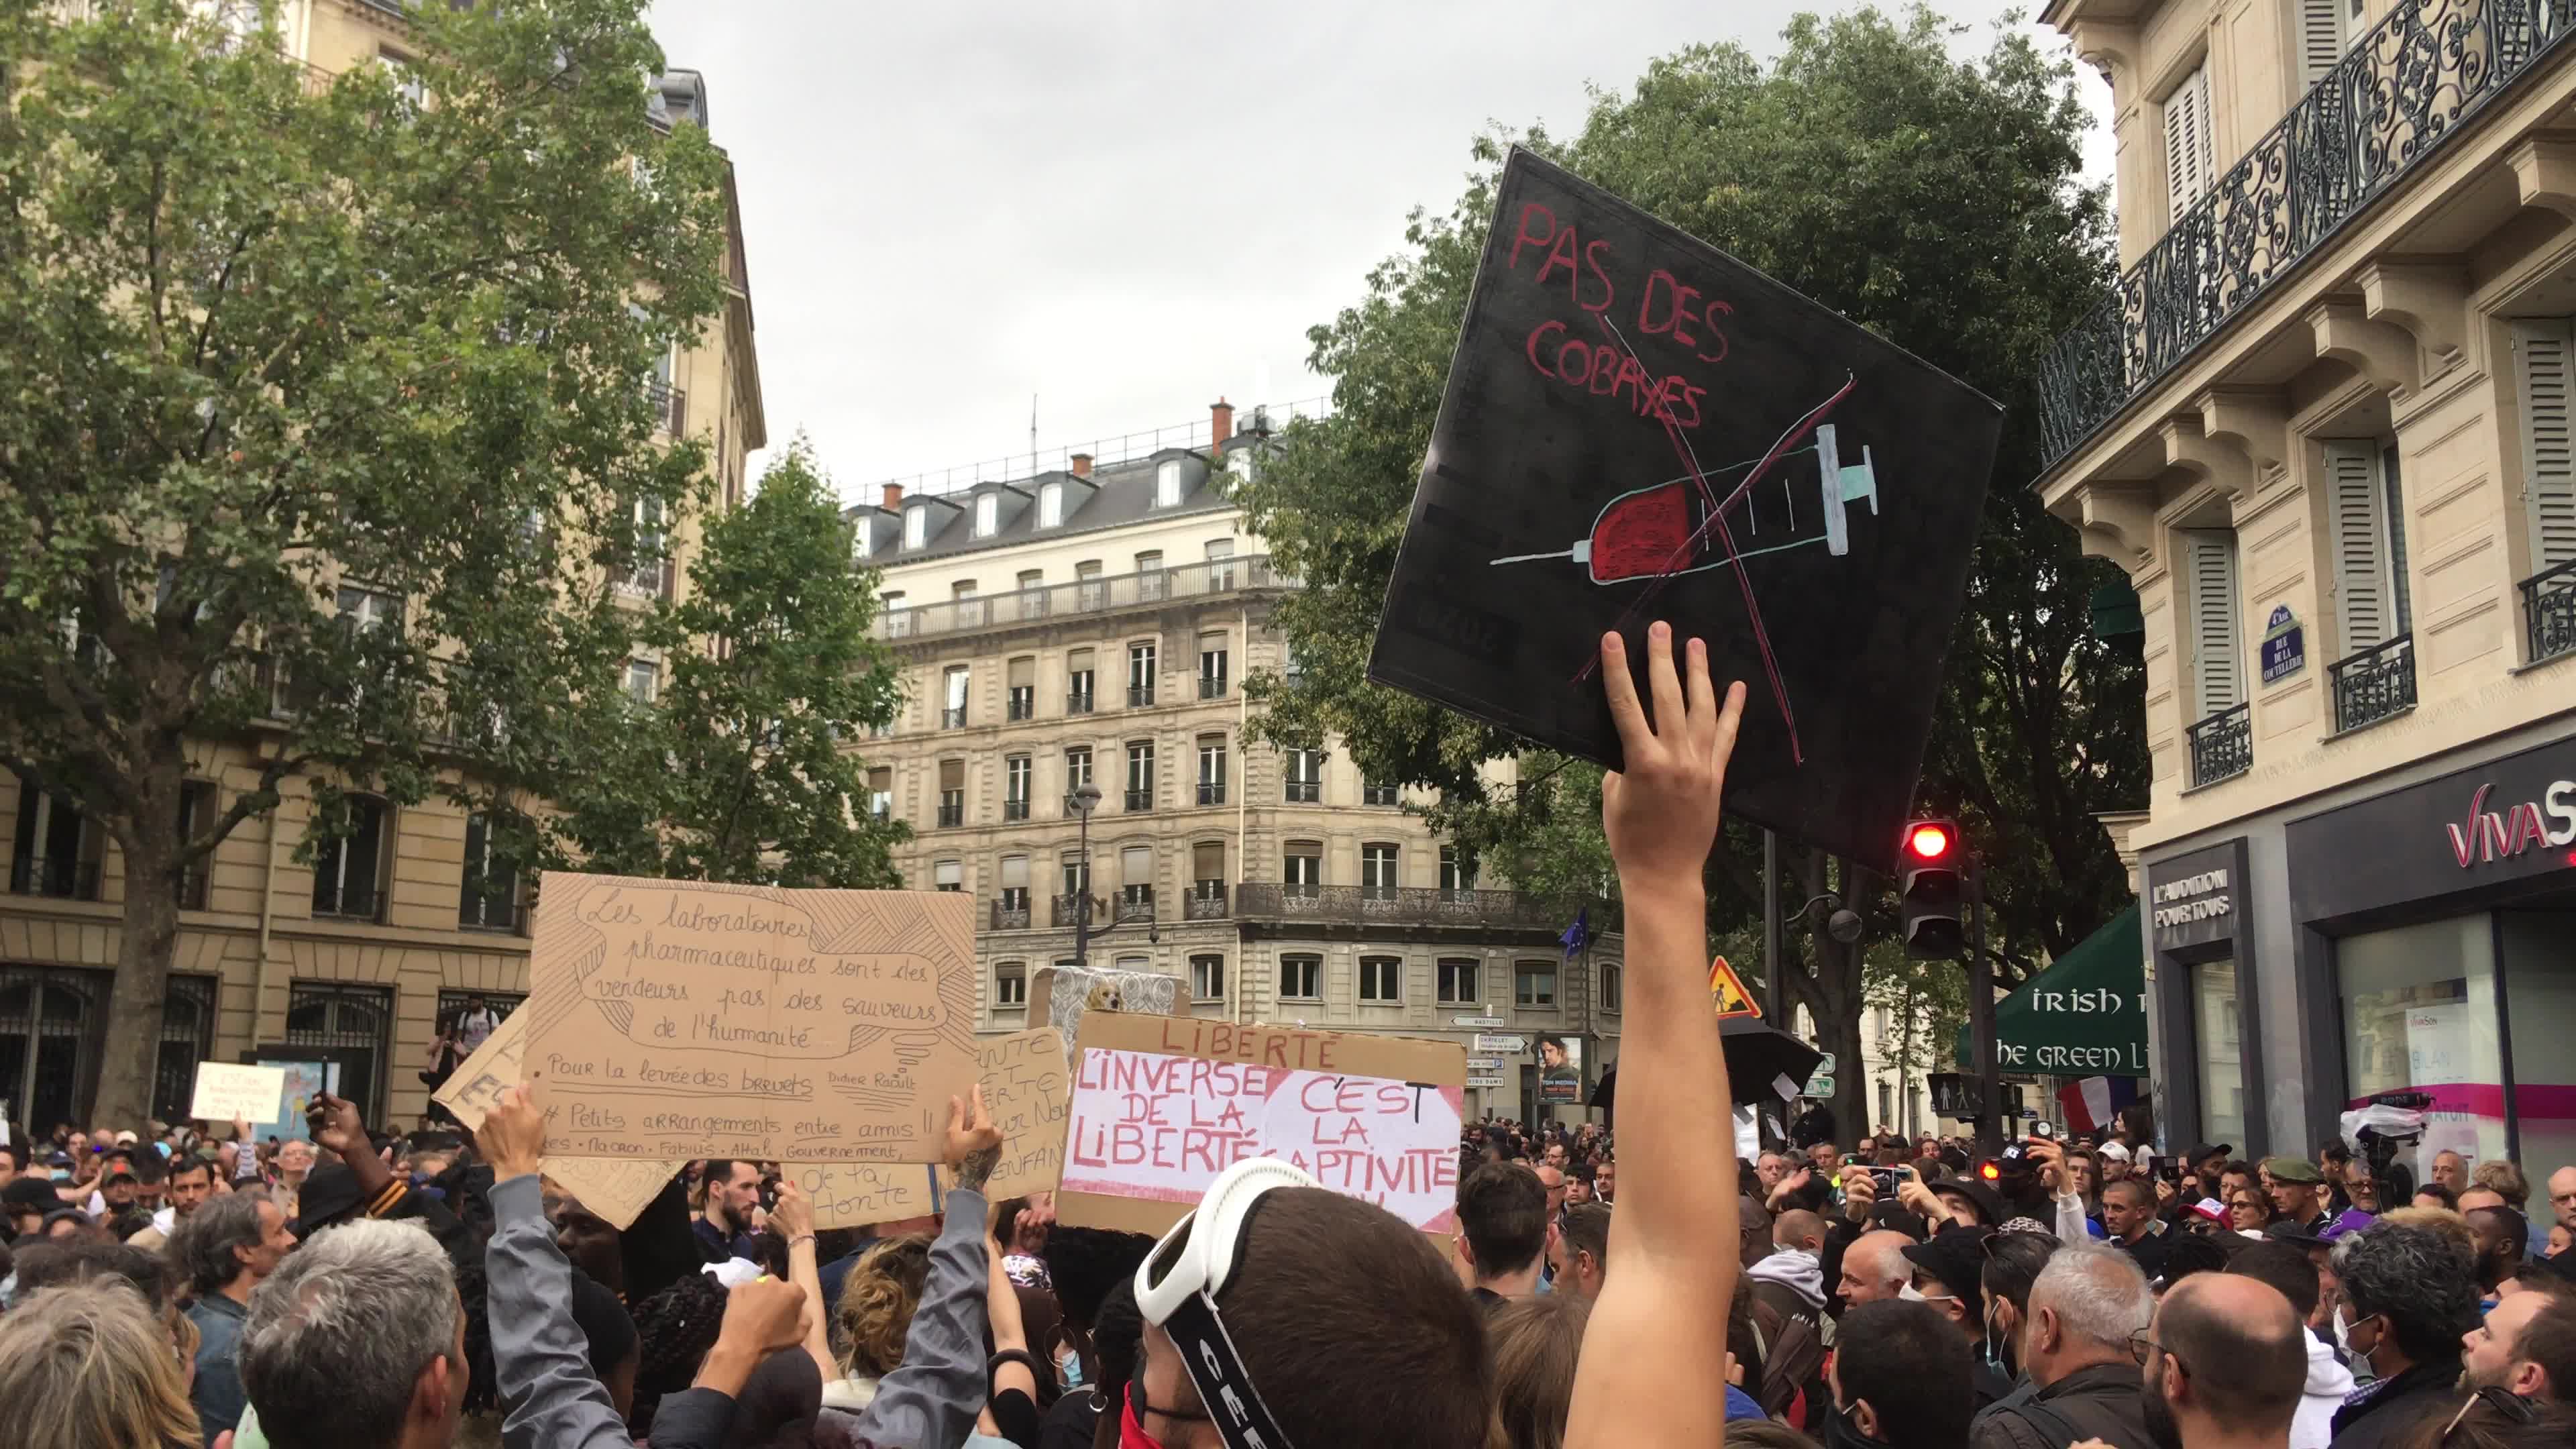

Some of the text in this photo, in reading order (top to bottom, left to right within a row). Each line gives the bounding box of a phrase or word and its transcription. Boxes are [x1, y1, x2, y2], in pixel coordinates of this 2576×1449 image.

[1509, 203, 1733, 363] PAS DES
[2274, 647, 2292, 663] DE LA
[2276, 636, 2288, 650] RUE
[2264, 654, 2303, 680] COUTELLERIE
[2153, 869, 2228, 904] L'AUDITION
[586, 888, 808, 937] Les laboratoires
[2155, 896, 2229, 928] POUR TOUS
[623, 930, 928, 984] pharmaceutiques sont des
[595, 977, 936, 1022] vendeurs pas des sauveurs
[654, 1014, 814, 1048] de l'humanité
[606, 1058, 627, 1078] la
[639, 1059, 689, 1084] levée
[692, 1067, 729, 1088] des
[874, 1073, 917, 1090] Raoult
[1120, 1093, 1244, 1130] DE LA
[1301, 1075, 1438, 1124] C'EST
[570, 1103, 627, 1128] Petits
[859, 1124, 913, 1139] amis
[1313, 1116, 1368, 1144] LA
